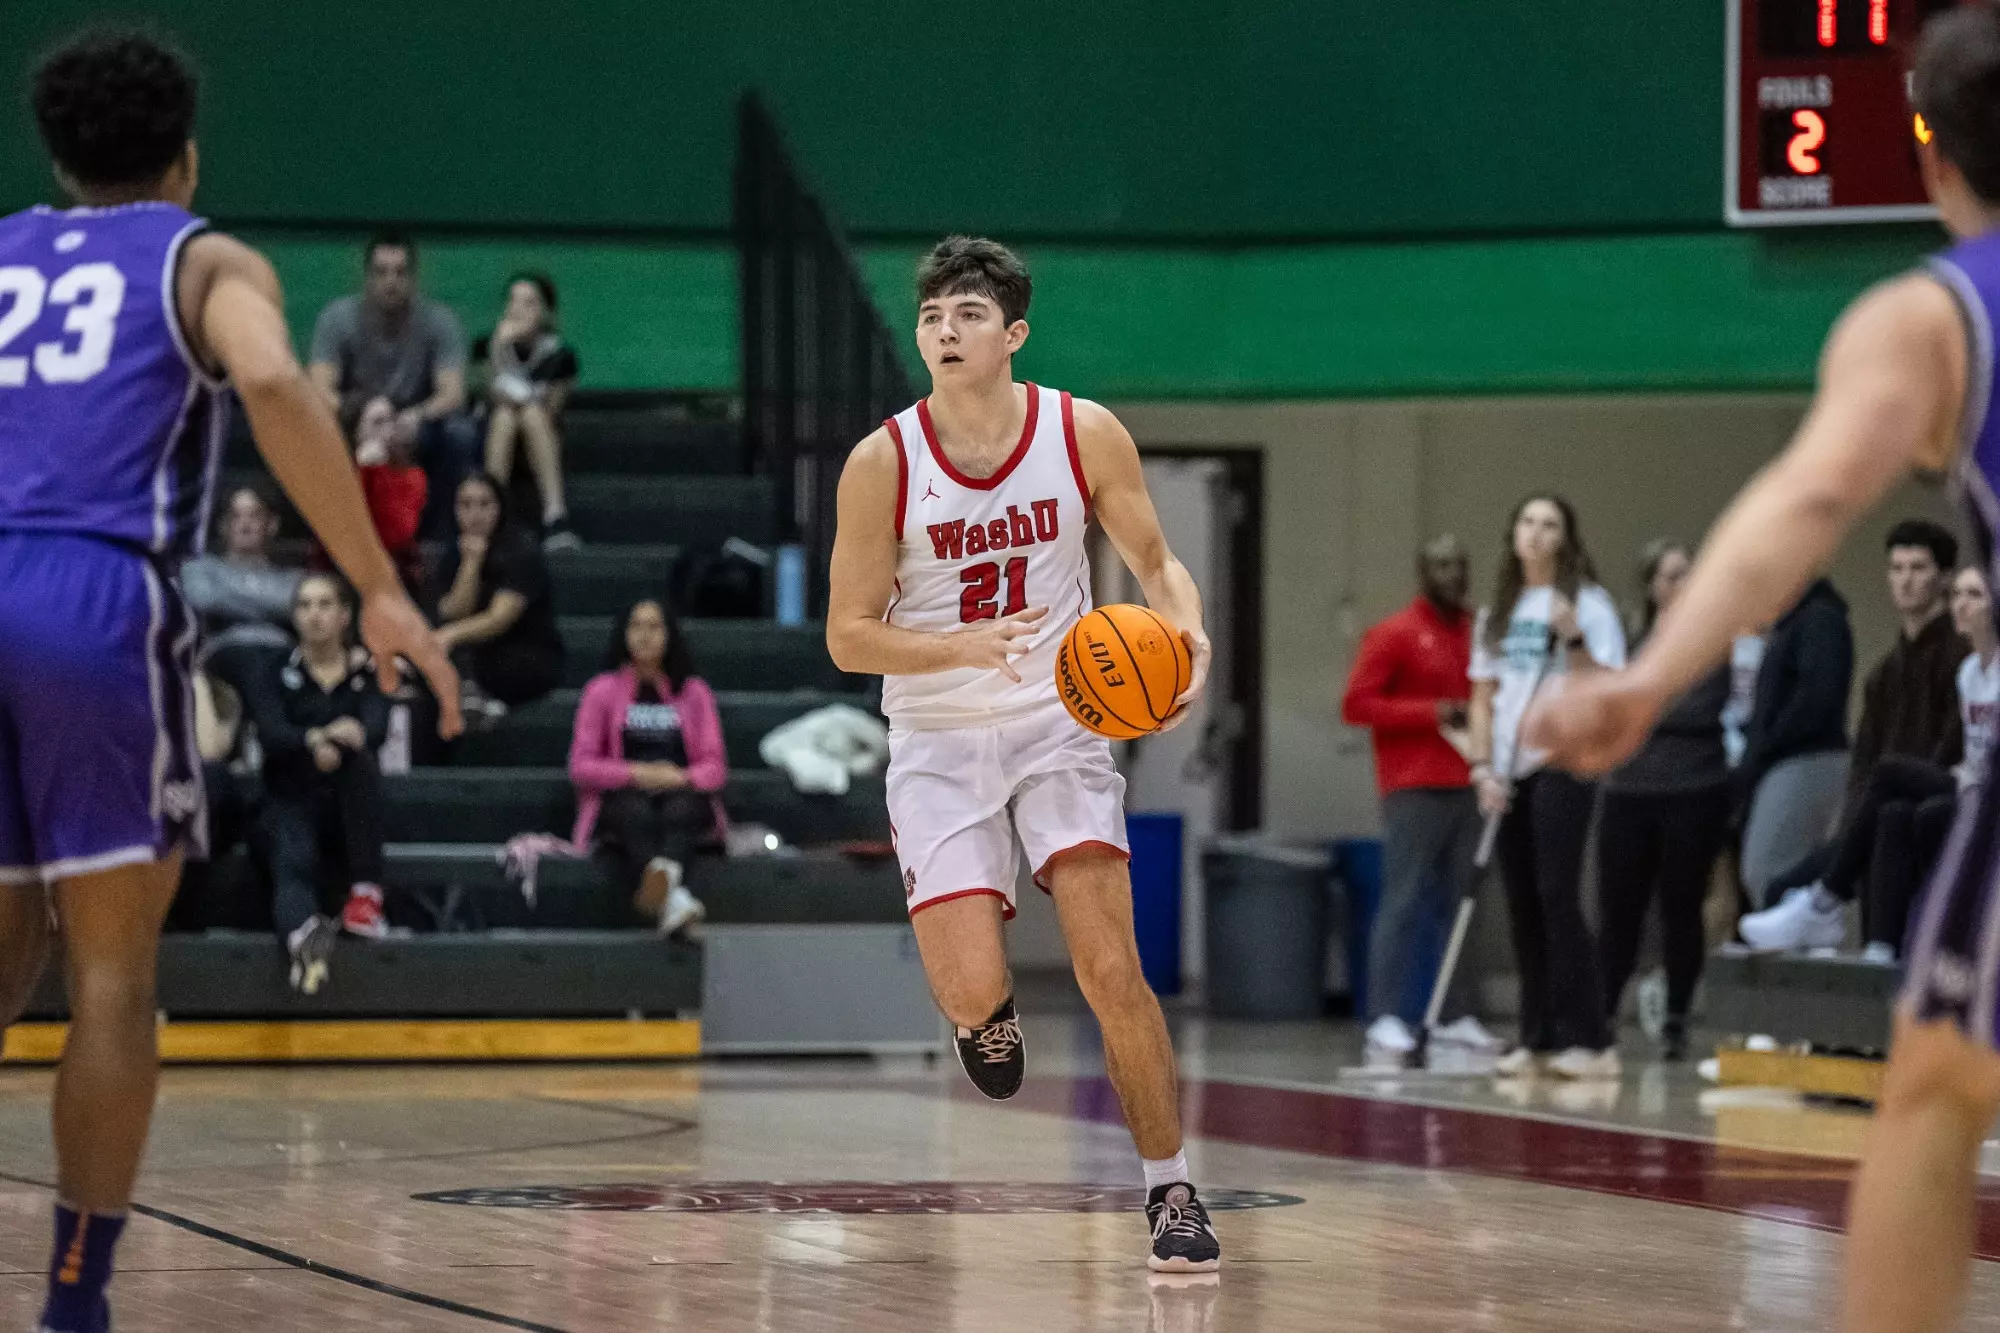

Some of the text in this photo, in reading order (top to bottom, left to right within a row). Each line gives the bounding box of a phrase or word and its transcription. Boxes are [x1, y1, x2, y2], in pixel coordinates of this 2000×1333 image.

[1758, 75, 1832, 108] FOULS
[1787, 109, 1826, 174] 2
[0, 261, 126, 388] 23
[926, 498, 1058, 560] WashU
[960, 556, 1028, 624] 21
